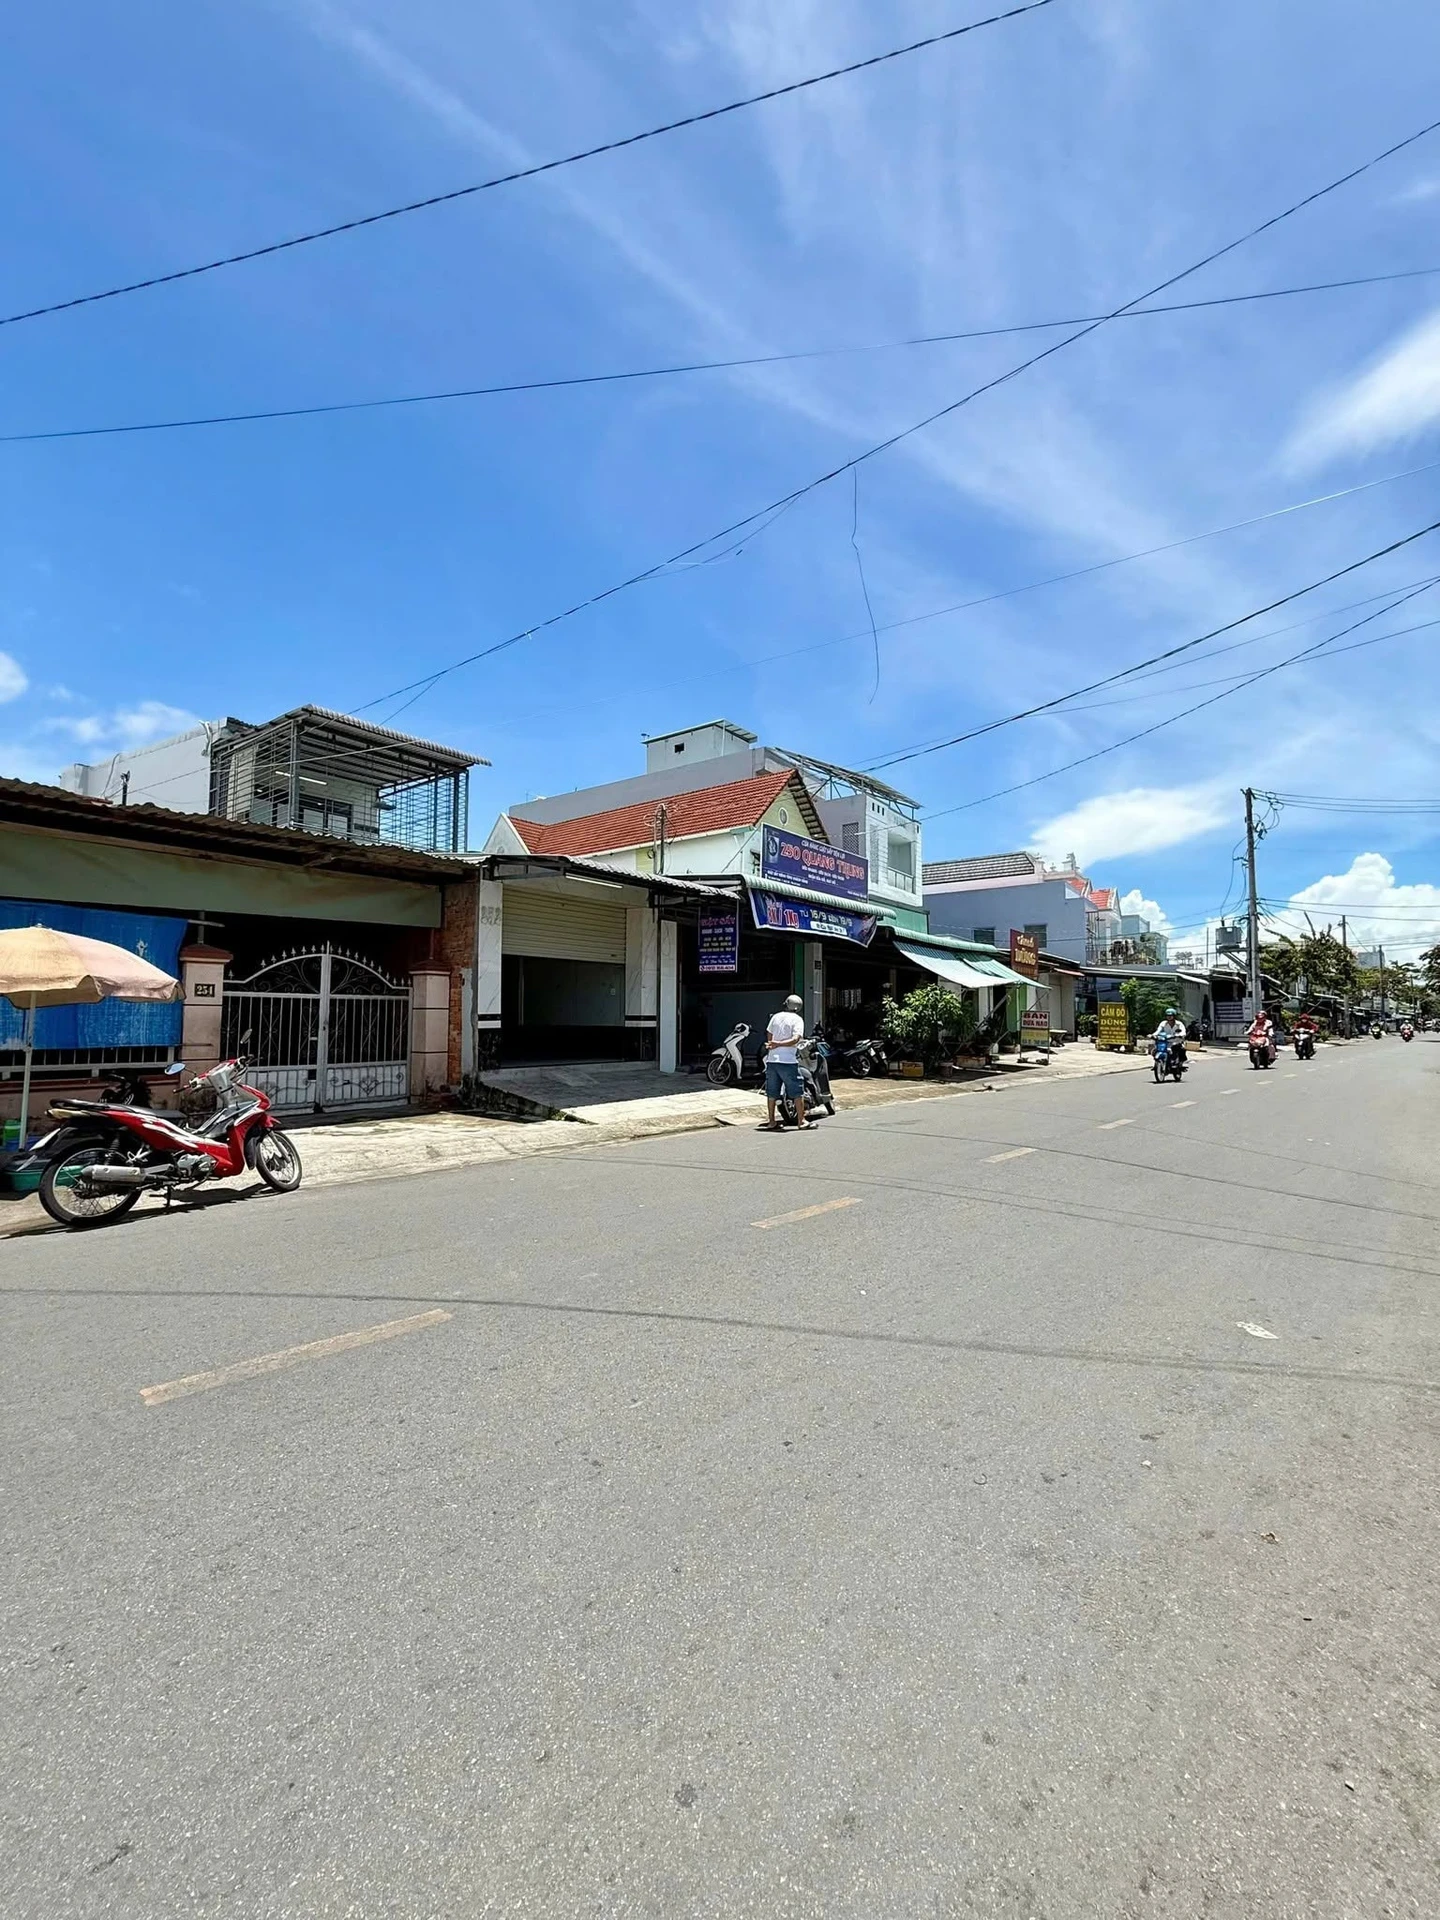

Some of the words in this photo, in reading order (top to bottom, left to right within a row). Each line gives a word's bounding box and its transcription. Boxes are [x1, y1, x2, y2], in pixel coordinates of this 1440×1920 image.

[780, 842, 801, 861] 250
[802, 849, 836, 871] QUANG
[196, 985, 213, 995] 251
[1100, 1017, 1126, 1026] DŨNG
